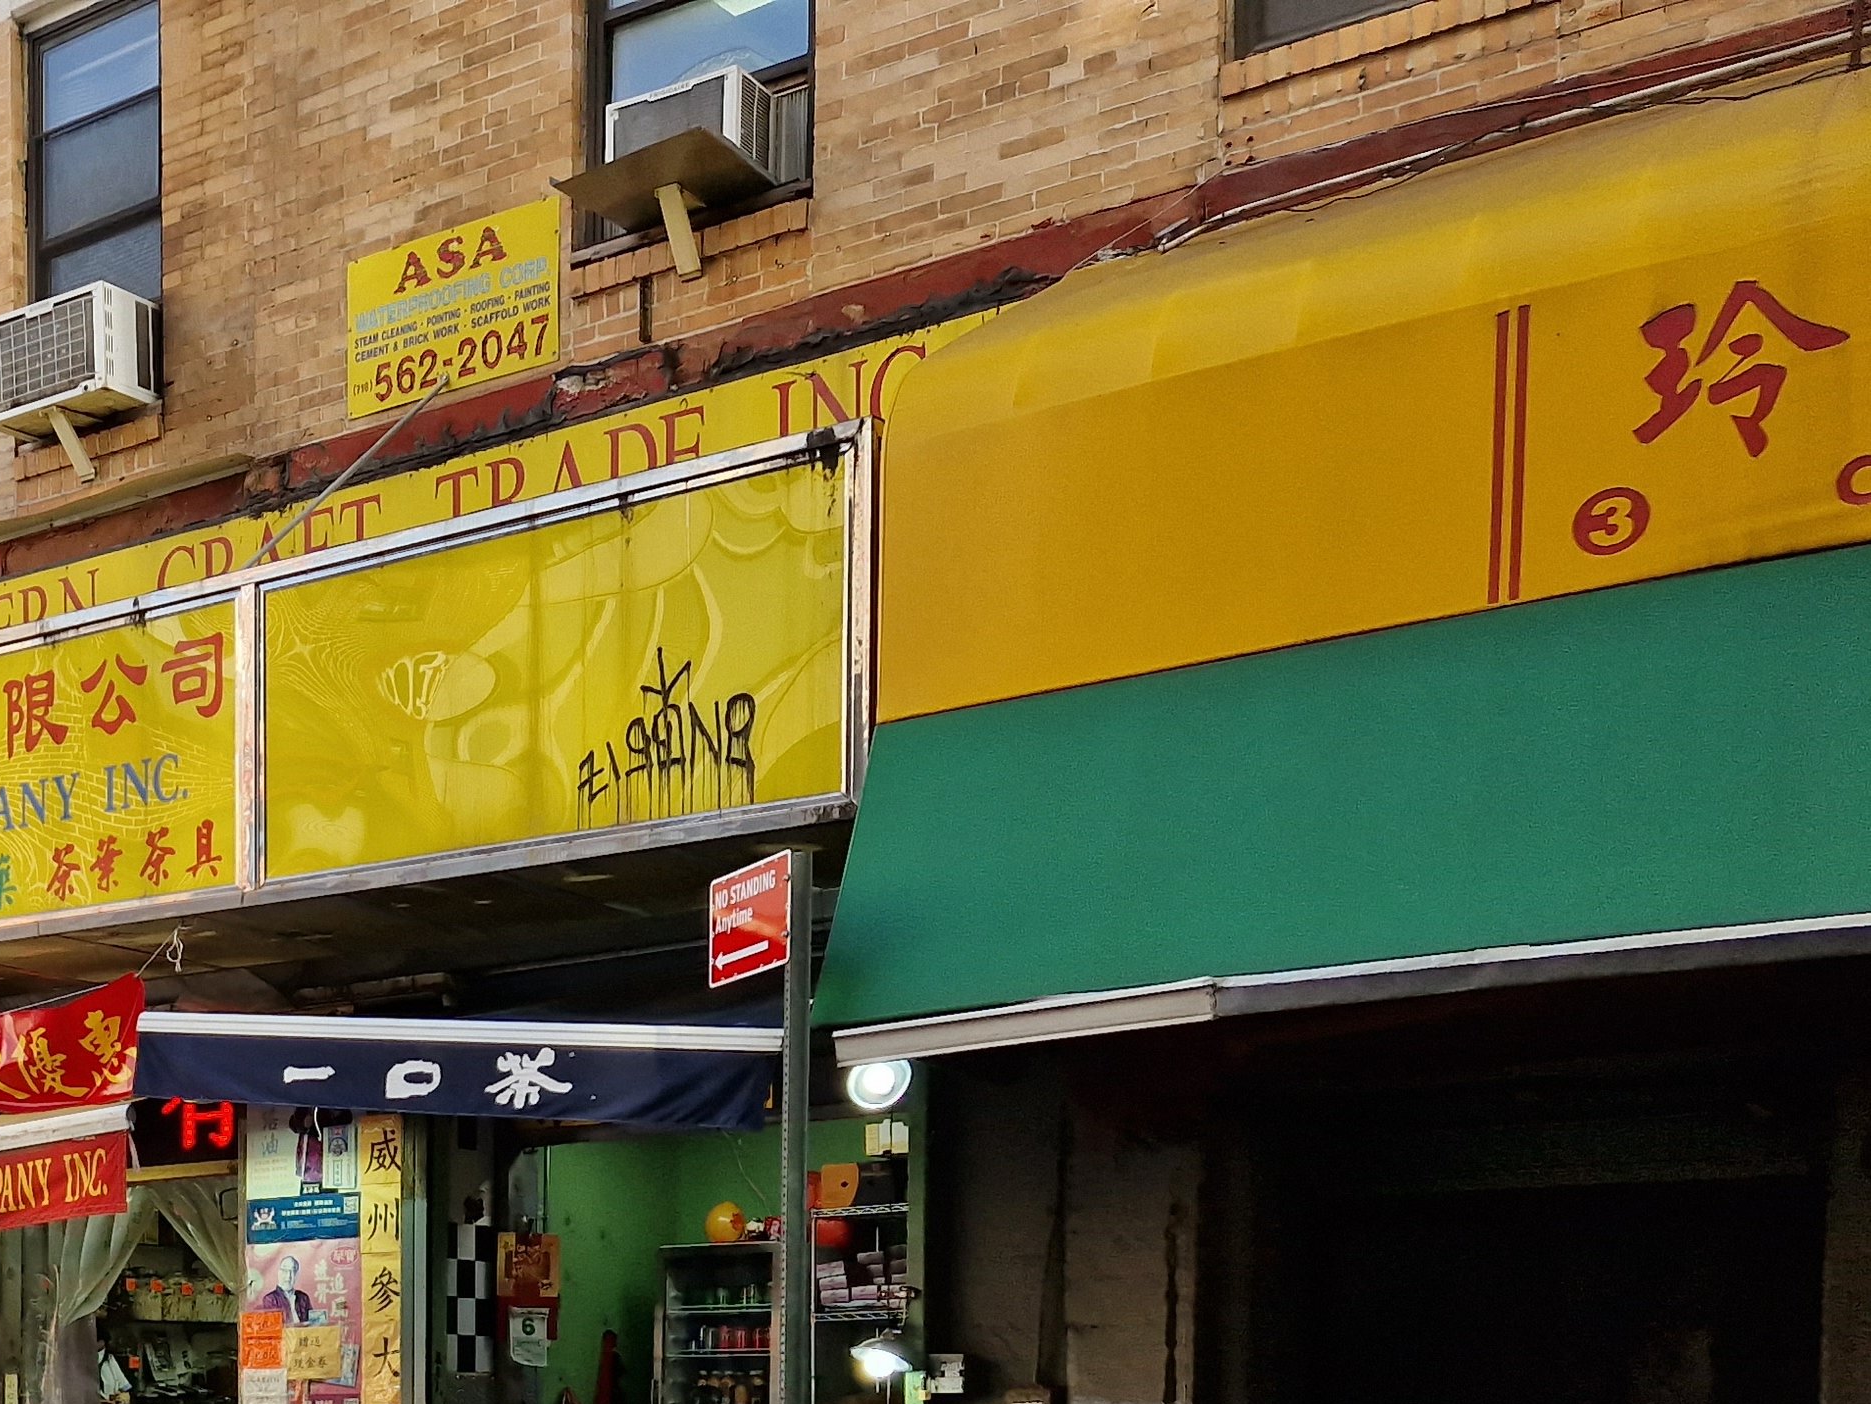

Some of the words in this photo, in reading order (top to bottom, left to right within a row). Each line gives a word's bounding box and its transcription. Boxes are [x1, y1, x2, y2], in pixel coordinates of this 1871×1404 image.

[393, 226, 507, 294] ASA
[355, 272, 492, 334] WATERPROOFING
[355, 333, 379, 349] STEAM
[381, 321, 418, 341] CLEANING
[426, 307, 461, 328] POINTING
[470, 295, 505, 313] ROOFING
[514, 281, 551, 301] PAINTING
[355, 346, 389, 363] CEMENT
[392, 341, 399, 351] &
[403, 333, 430, 348] BRICK
[433, 323, 460, 340] WORK
[470, 305, 519, 329] SCAFFOLD
[523, 295, 551, 313] WORK
[375, 313, 550, 402] 562-2047
[1632, 280, 1851, 458] 玲
[104, 753, 189, 813] INC.
[46, 834, 123, 901] 茶葉
[139, 819, 222, 886] 茶具
[714, 891, 728, 909] NO
[729, 870, 776, 904] STANDING
[715, 907, 754, 934] Anytime
[63, 1148, 108, 1203] INC.
[521, 1317, 536, 1336] 6
